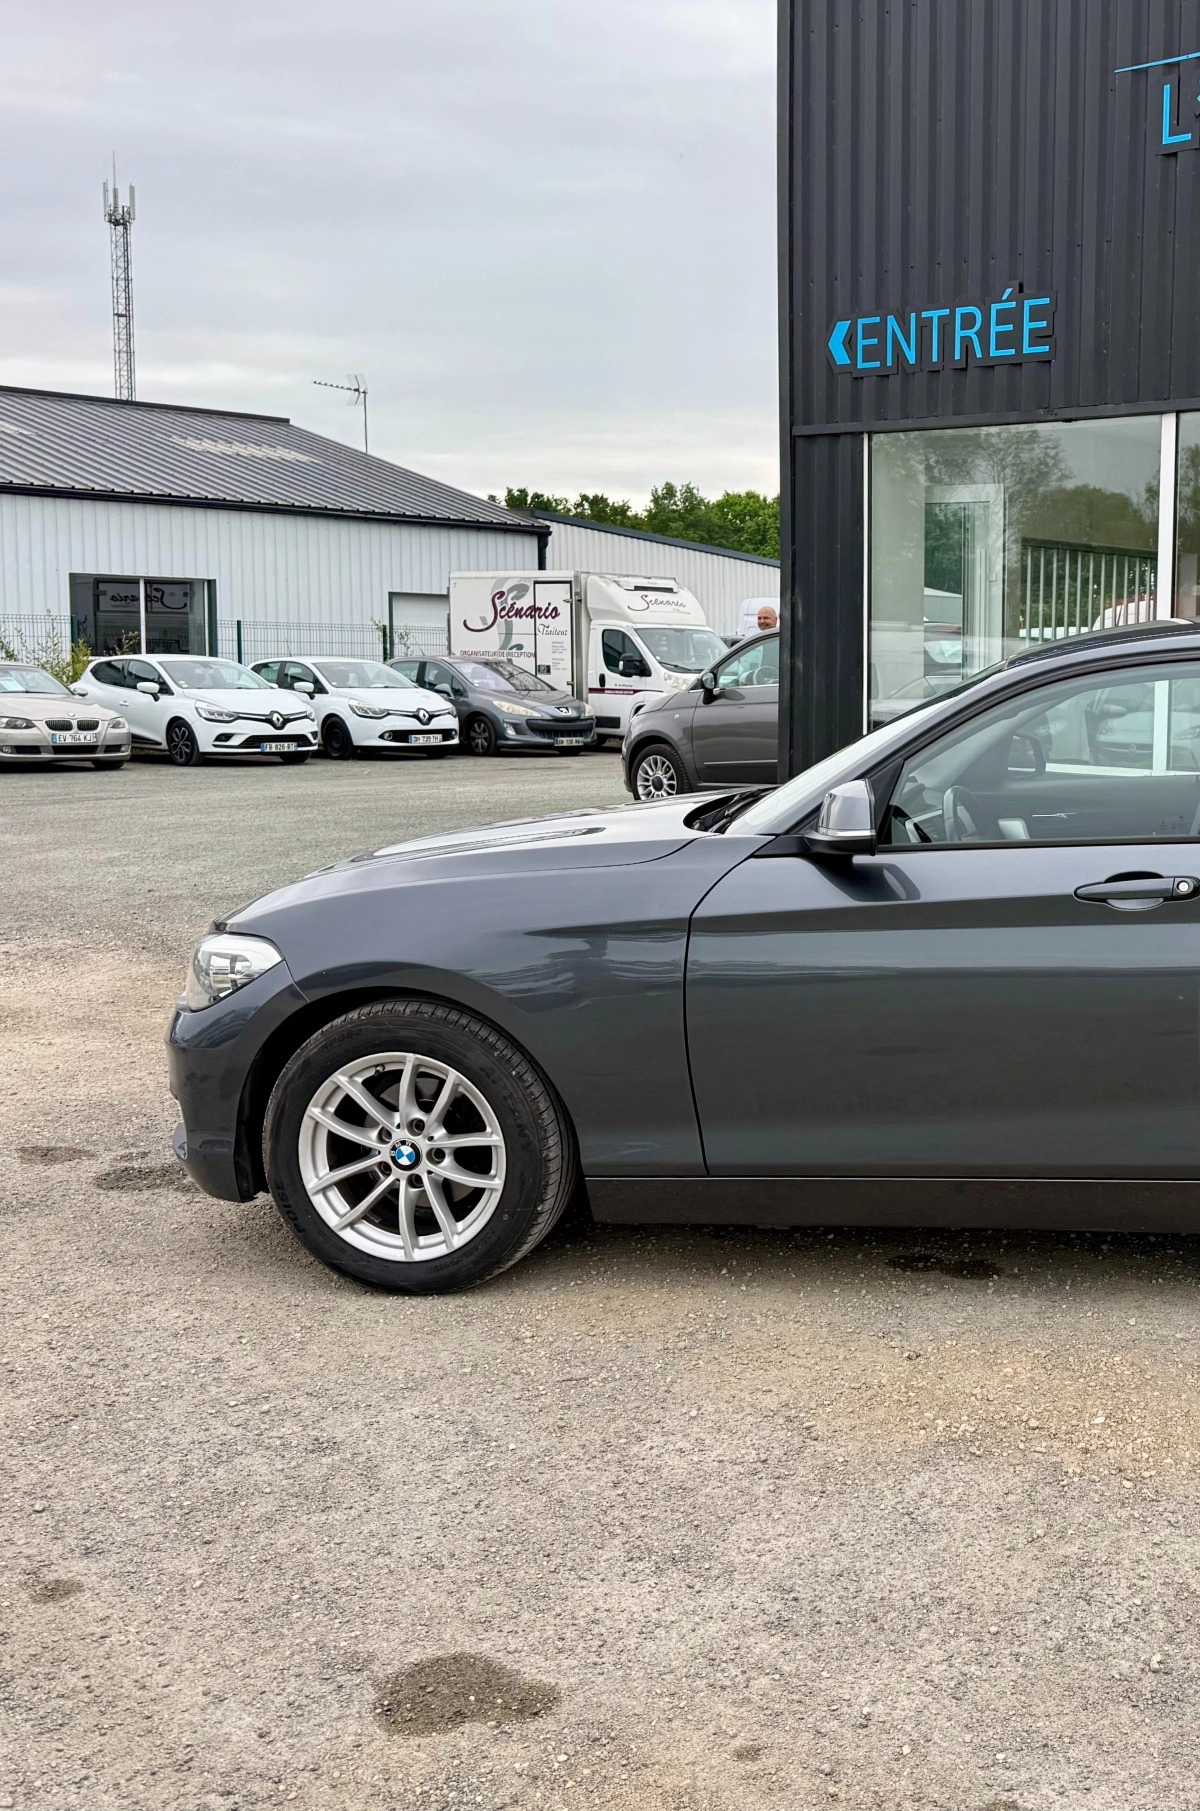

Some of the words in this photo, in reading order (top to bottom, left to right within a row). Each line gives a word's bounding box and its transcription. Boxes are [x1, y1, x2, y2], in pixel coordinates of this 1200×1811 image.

[857, 288, 1050, 369] ENTRÉE
[463, 590, 560, 632] Scénario
[274, 1178, 306, 1234] POISE
